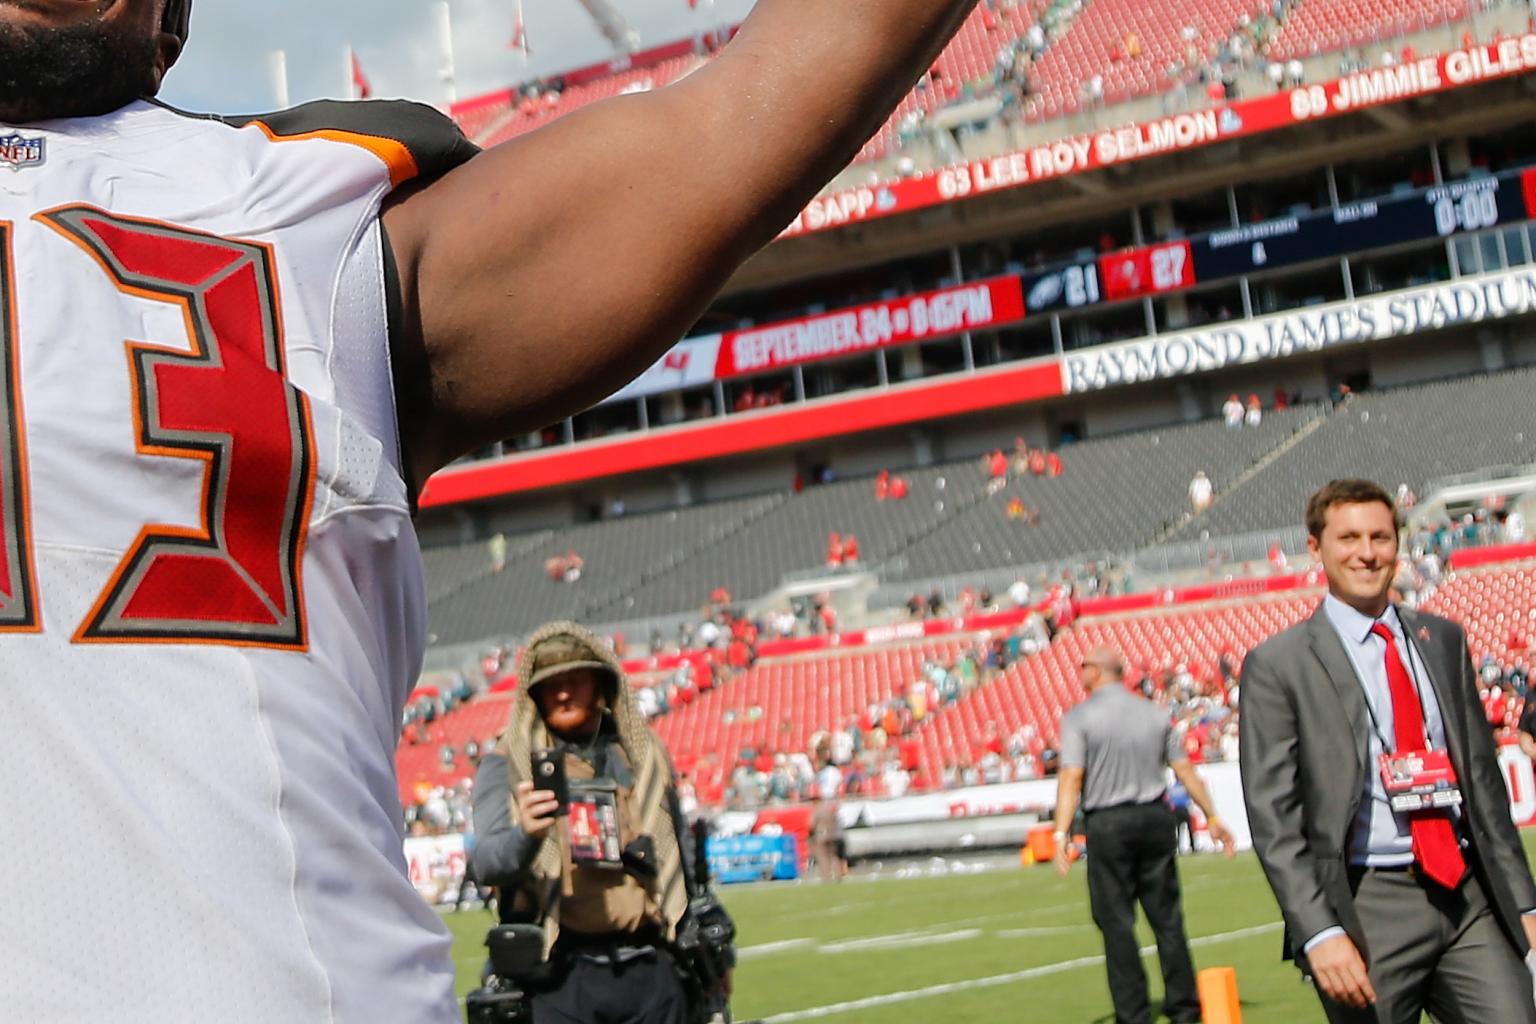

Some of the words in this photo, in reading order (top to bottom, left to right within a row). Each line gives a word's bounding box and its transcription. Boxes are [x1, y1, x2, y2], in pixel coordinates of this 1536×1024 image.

[1332, 57, 1441, 111] JIMMIE
[1445, 32, 1536, 85] GILES
[974, 153, 1030, 193] LEE
[1031, 137, 1092, 178] ROY
[1094, 108, 1219, 165] SELMON
[804, 187, 874, 230] SAPP
[1434, 189, 1499, 236] 0:00
[731, 311, 862, 372] SEPTEMBER
[1066, 330, 1248, 390] RAYMOND
[1255, 303, 1377, 358] JAMES
